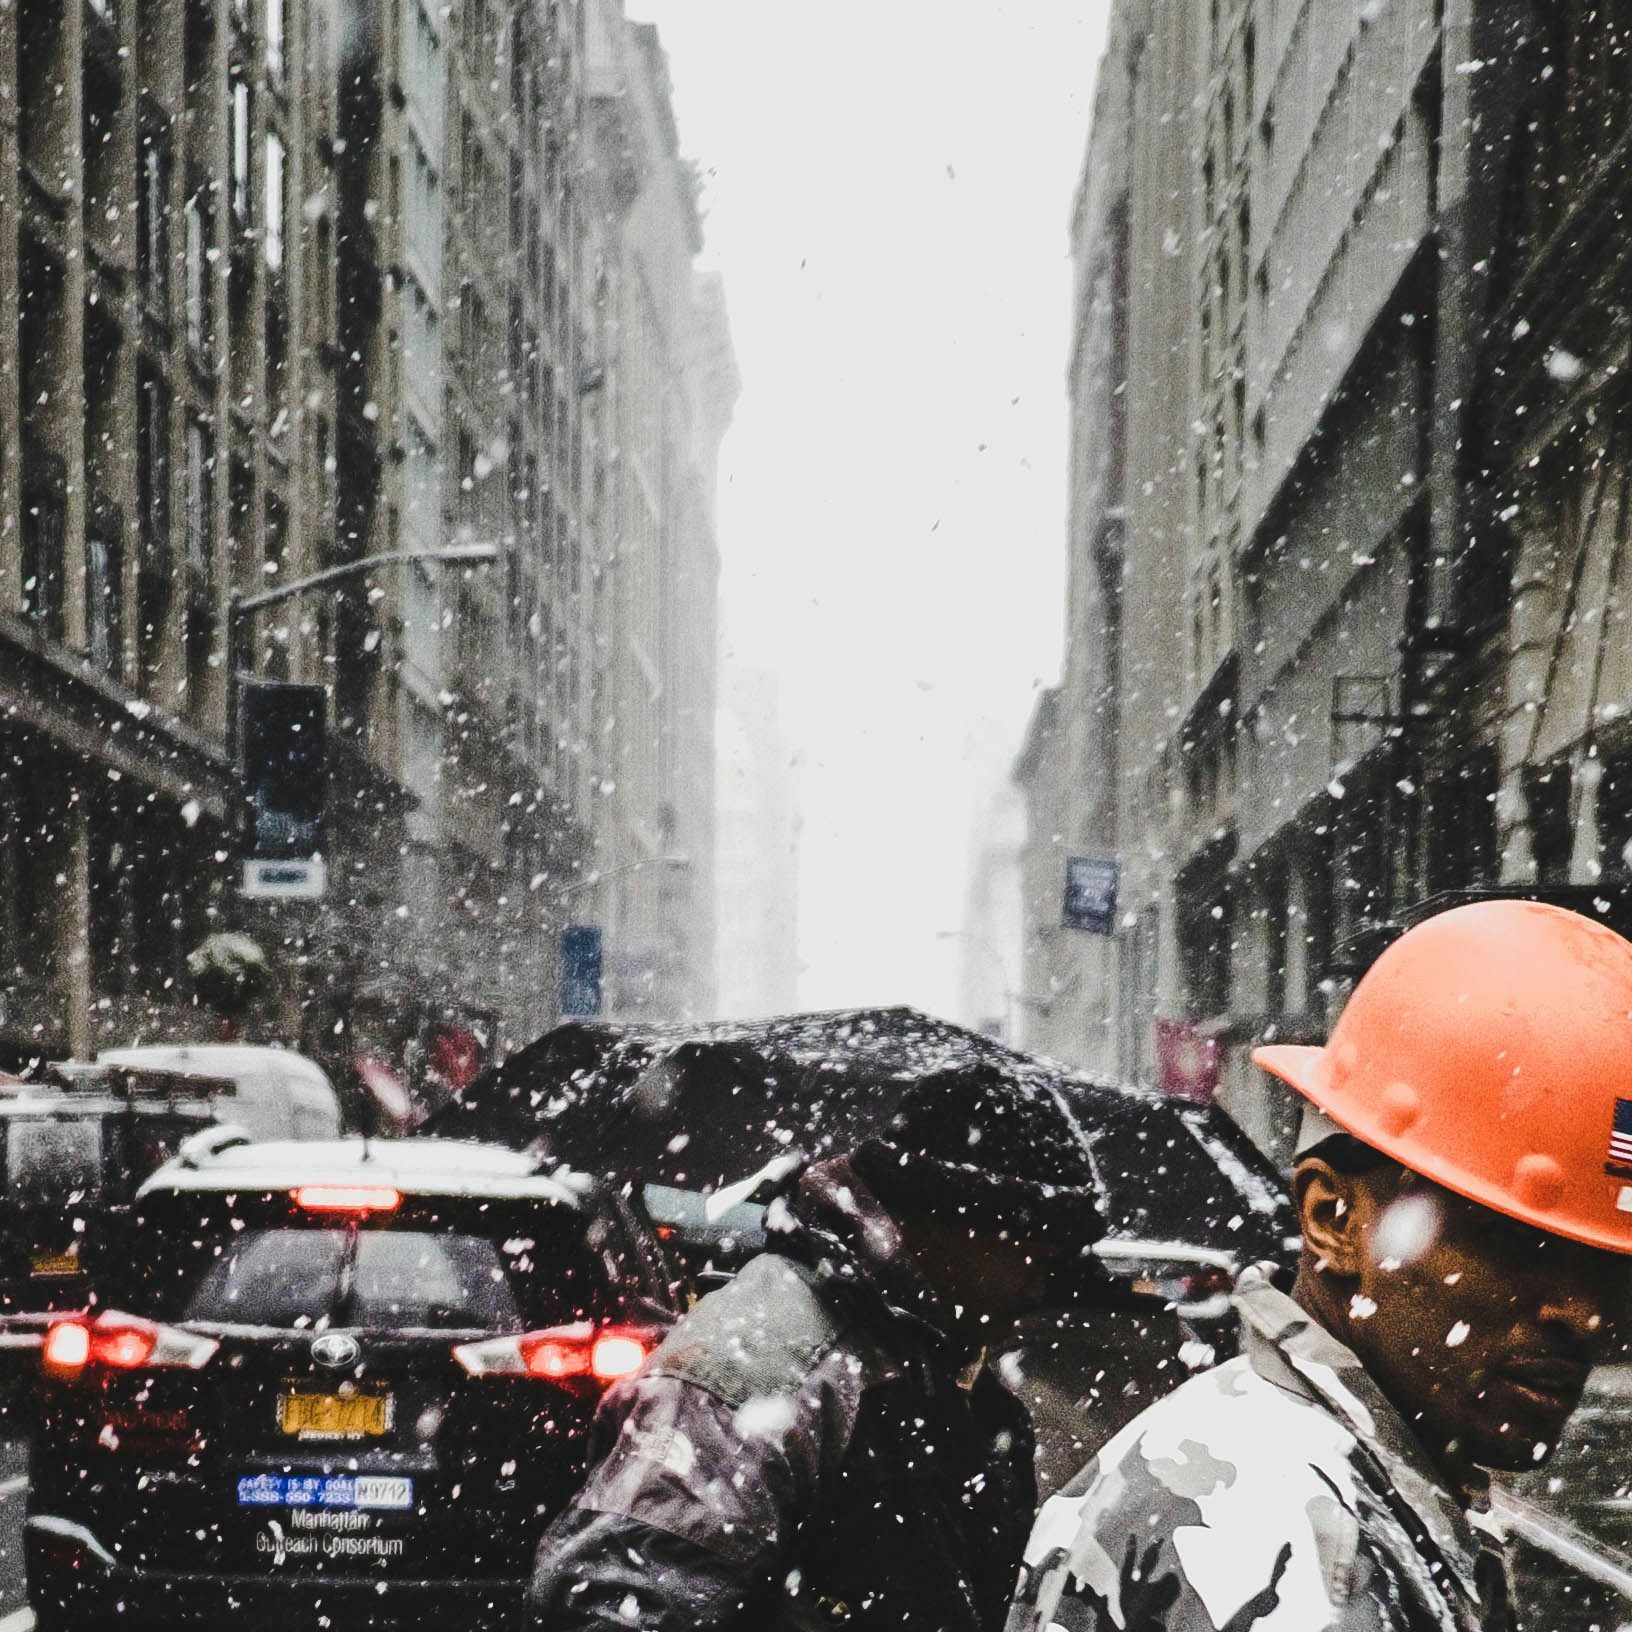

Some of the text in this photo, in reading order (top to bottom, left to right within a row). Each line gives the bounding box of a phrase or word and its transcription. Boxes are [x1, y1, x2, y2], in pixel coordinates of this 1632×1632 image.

[291, 1508, 371, 1530] Manhattan
[256, 1531, 403, 1555] Oureach Consortium
